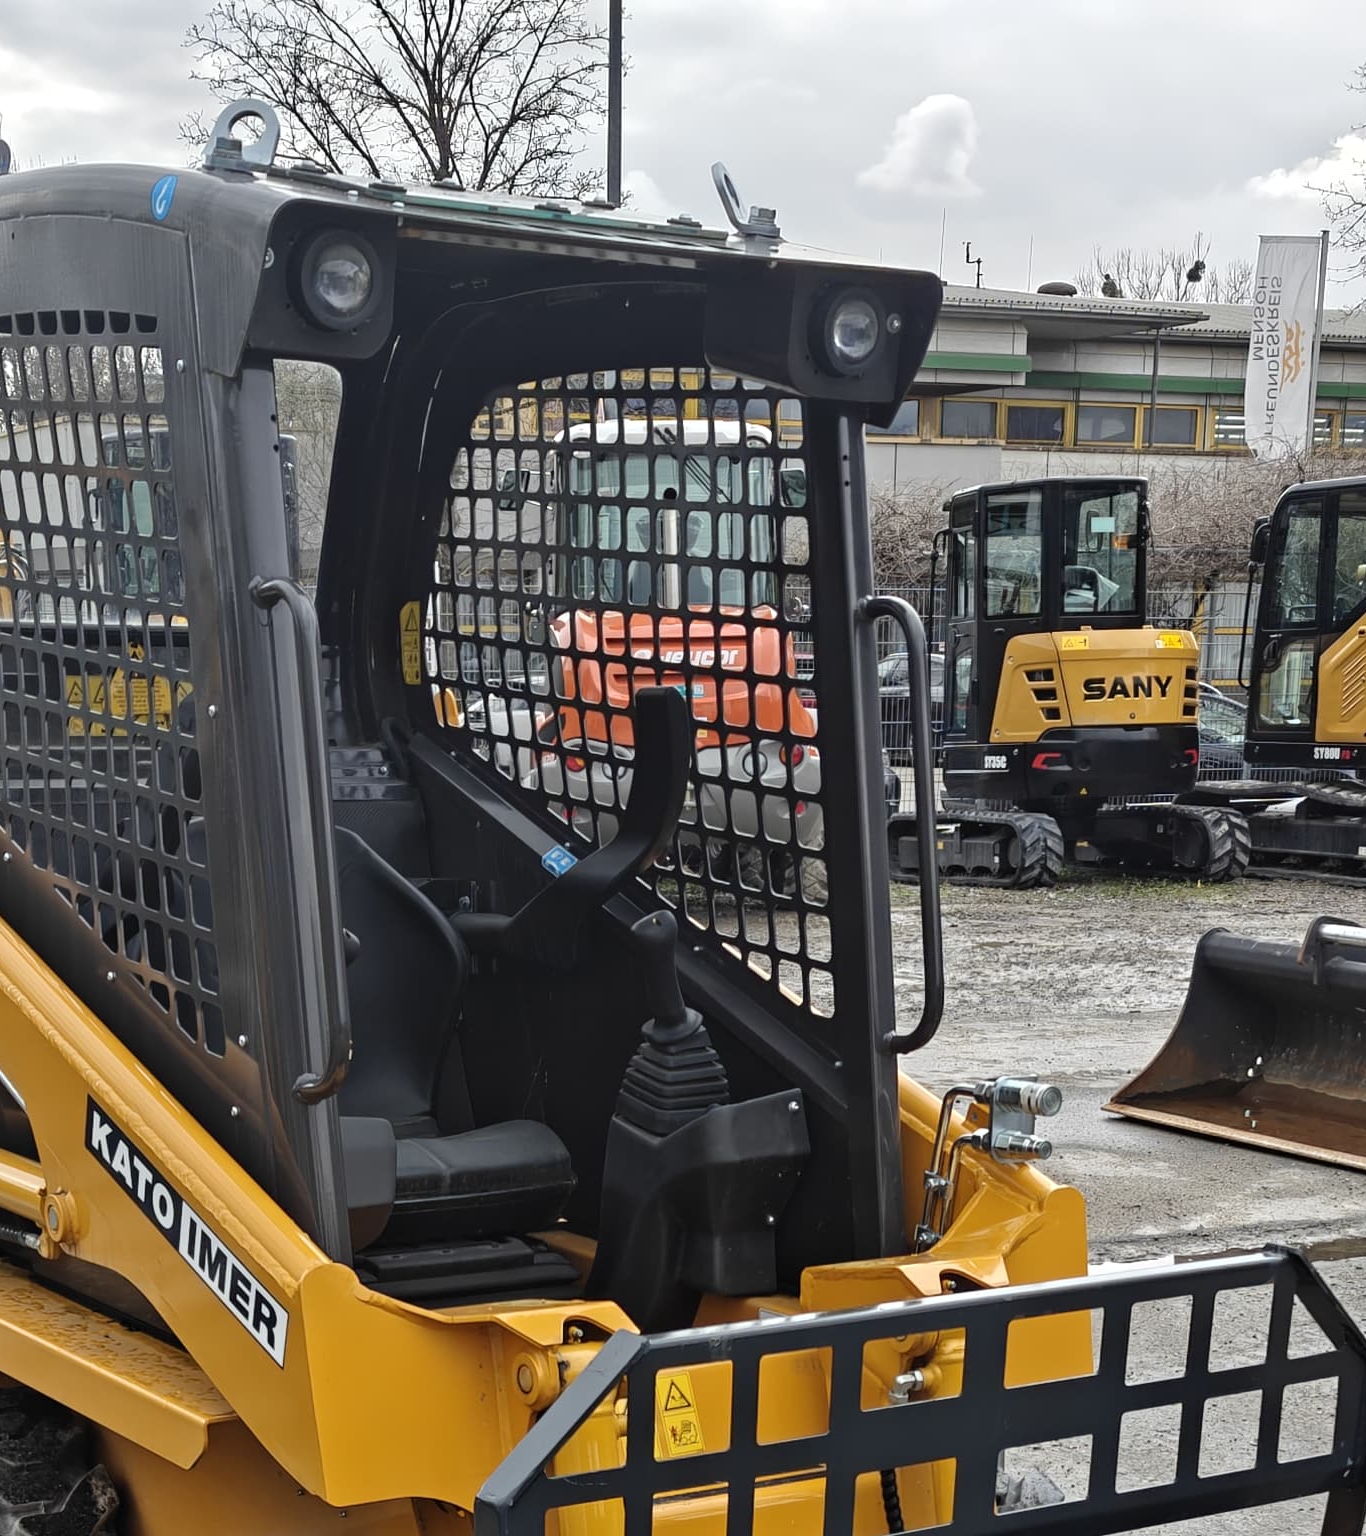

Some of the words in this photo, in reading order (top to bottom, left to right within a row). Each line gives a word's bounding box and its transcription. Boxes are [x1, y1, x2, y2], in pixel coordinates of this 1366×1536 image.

[1083, 675, 1173, 701] SANY
[91, 1110, 175, 1230] KATO
[186, 1215, 278, 1352] IMER
